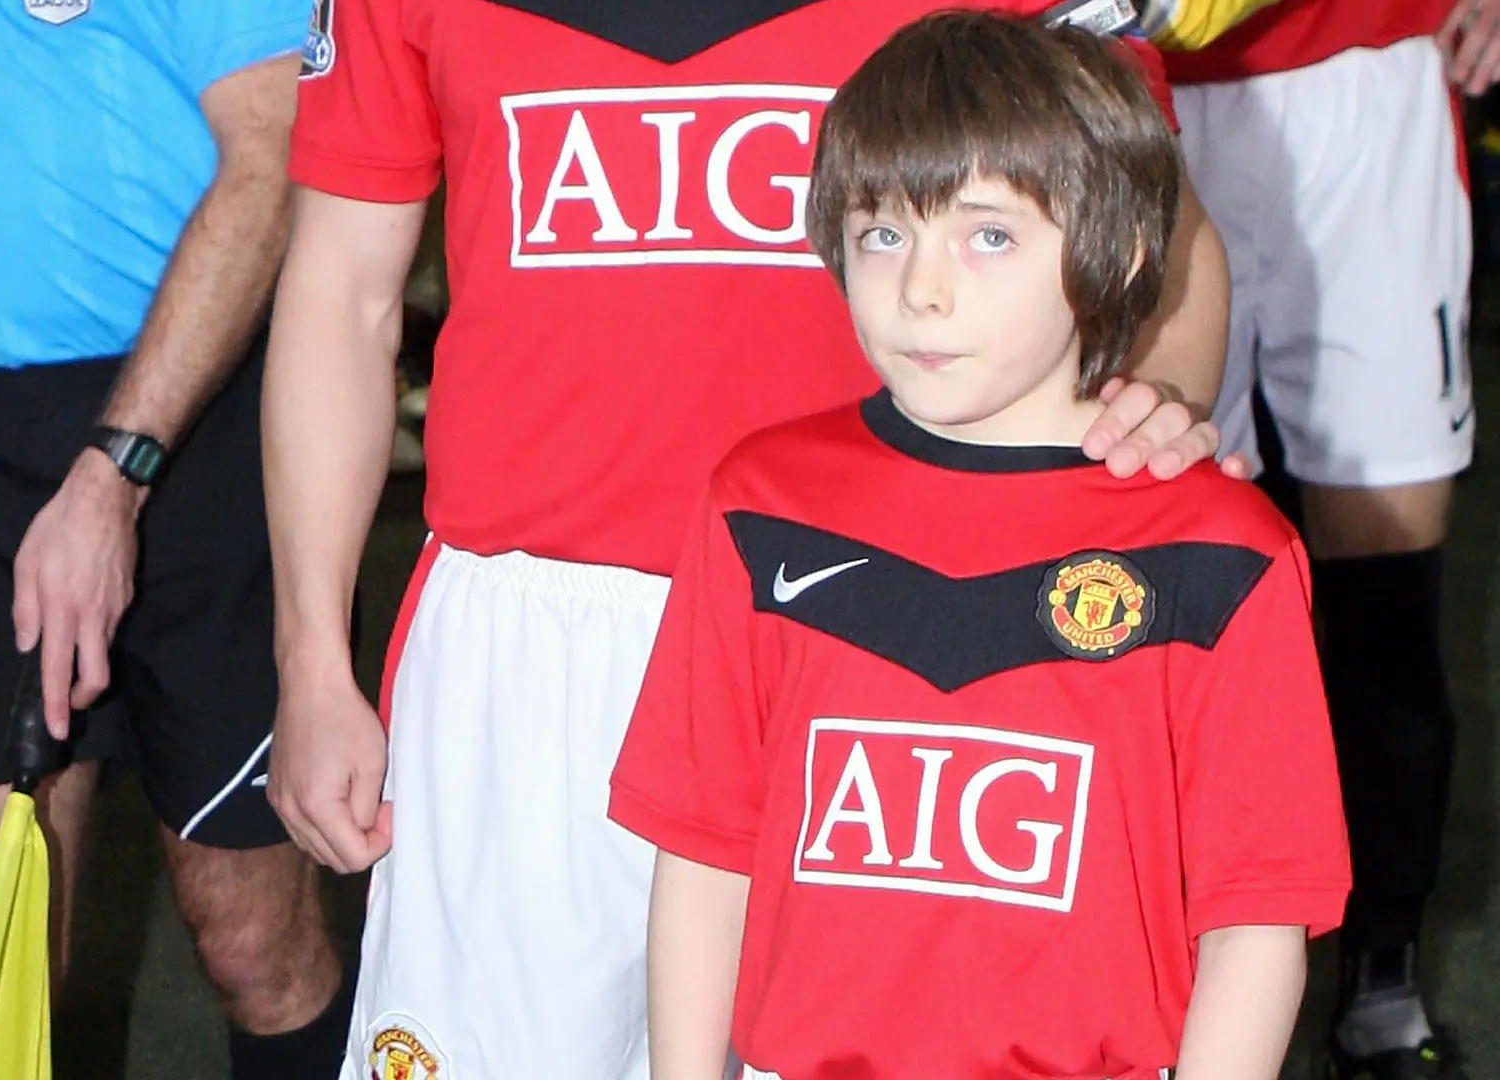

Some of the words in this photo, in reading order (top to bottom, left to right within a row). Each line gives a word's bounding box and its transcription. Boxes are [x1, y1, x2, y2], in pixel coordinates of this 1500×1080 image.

[525, 109, 812, 245] AIG
[1062, 563, 1137, 605] MANCHESTER
[1061, 621, 1116, 645] UNITED
[804, 739, 1064, 885] AIG
